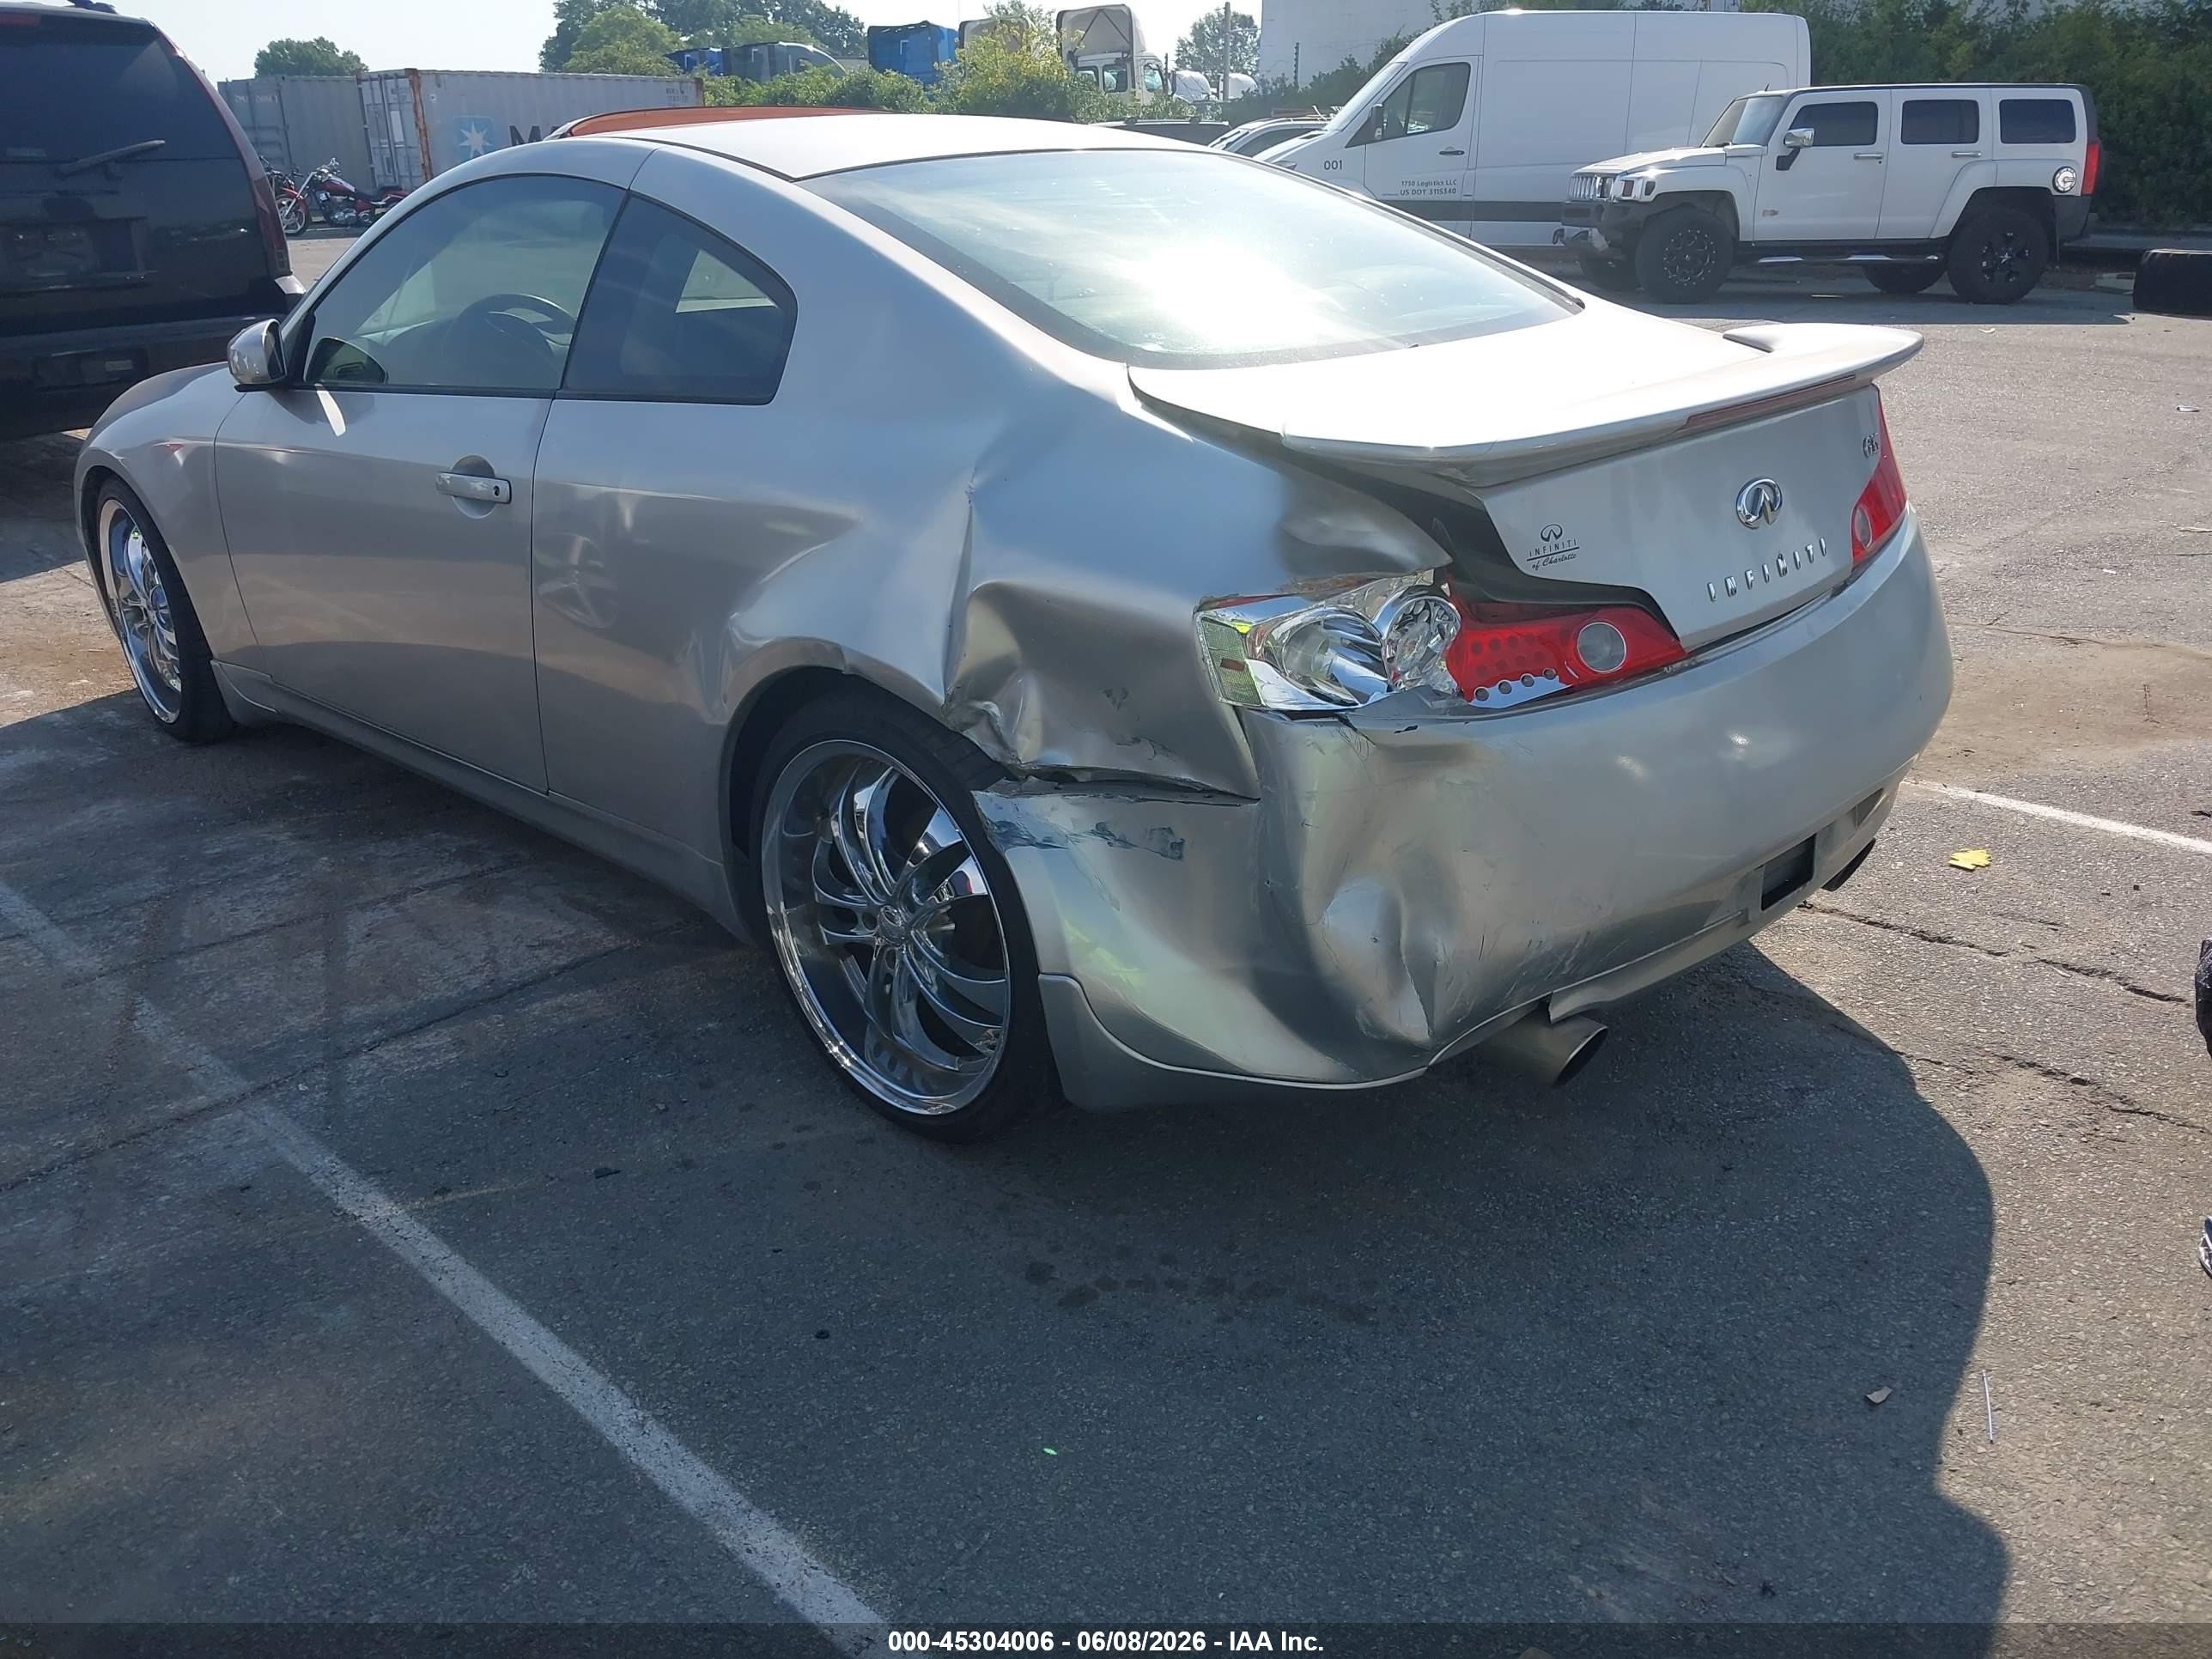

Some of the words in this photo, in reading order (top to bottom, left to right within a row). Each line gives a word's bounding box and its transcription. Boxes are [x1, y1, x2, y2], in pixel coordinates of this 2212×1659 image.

[1324, 160, 1343, 171] 001
[1529, 538, 1577, 557] INFINITI
[1532, 560, 1540, 571] of
[1542, 553, 1577, 567] Charlotte
[1707, 537, 1827, 602] INFINITI
